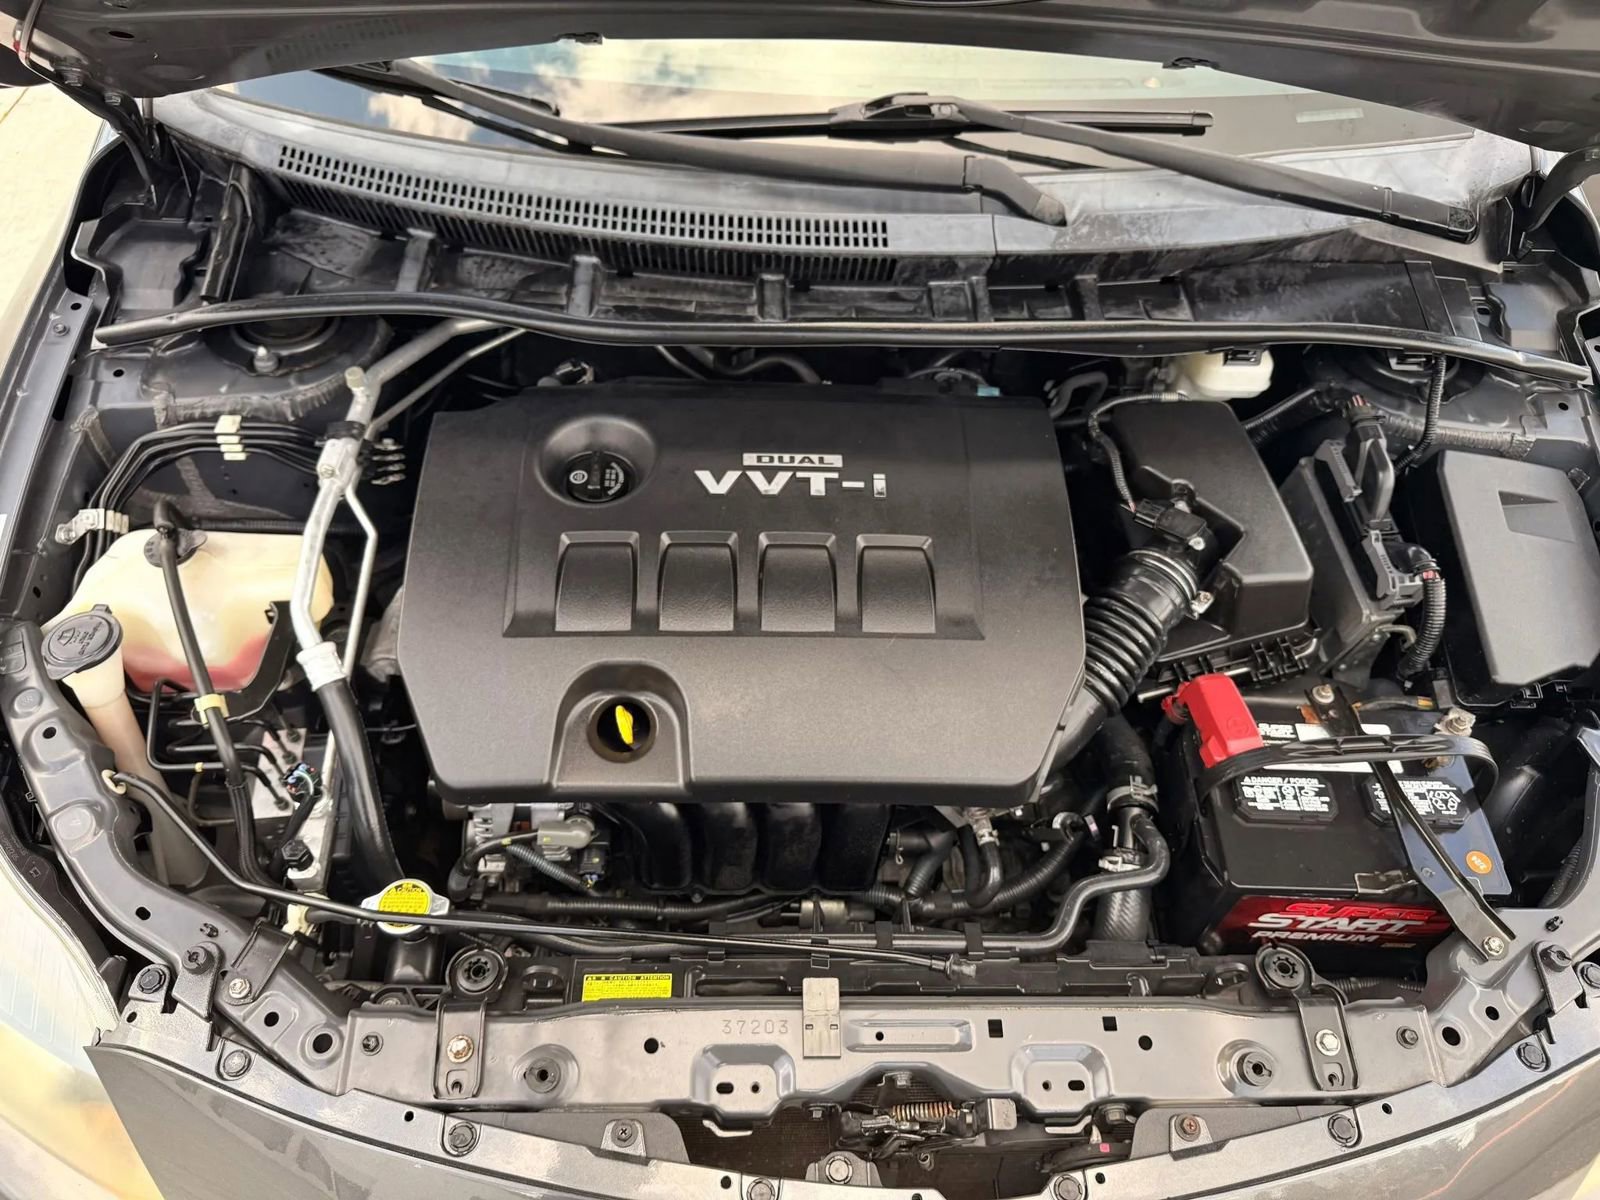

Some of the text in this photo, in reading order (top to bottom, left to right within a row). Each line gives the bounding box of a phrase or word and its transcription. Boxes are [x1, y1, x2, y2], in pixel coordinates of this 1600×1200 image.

[756, 454, 834, 466] DUAL
[694, 470, 887, 498] VVT-i
[1250, 776, 1283, 784] DANGER
[1289, 777, 1319, 785] POISON
[1279, 902, 1437, 920] SUPER
[1248, 913, 1425, 935] START
[1251, 930, 1381, 943] PREMIUM
[721, 1019, 789, 1035] 37203
